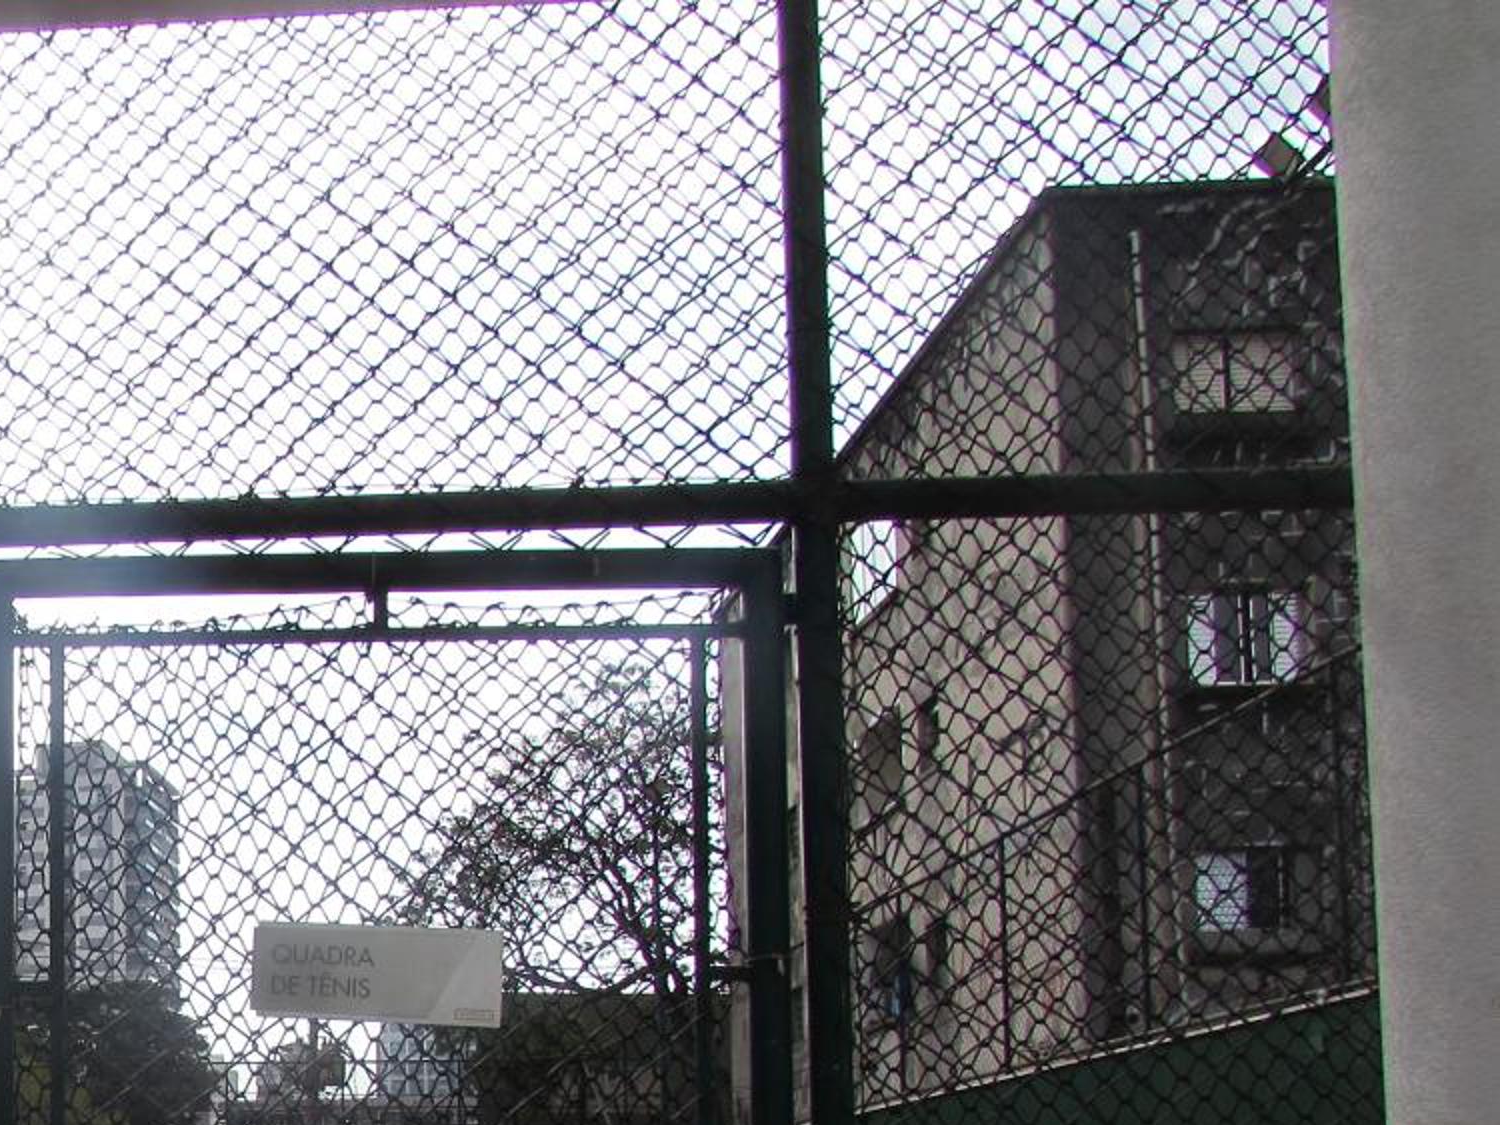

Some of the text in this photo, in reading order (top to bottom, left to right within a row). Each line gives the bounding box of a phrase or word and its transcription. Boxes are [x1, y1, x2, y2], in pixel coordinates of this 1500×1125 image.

[271, 943, 375, 968] QUADRA
[270, 972, 372, 999] DE TÊNIS
